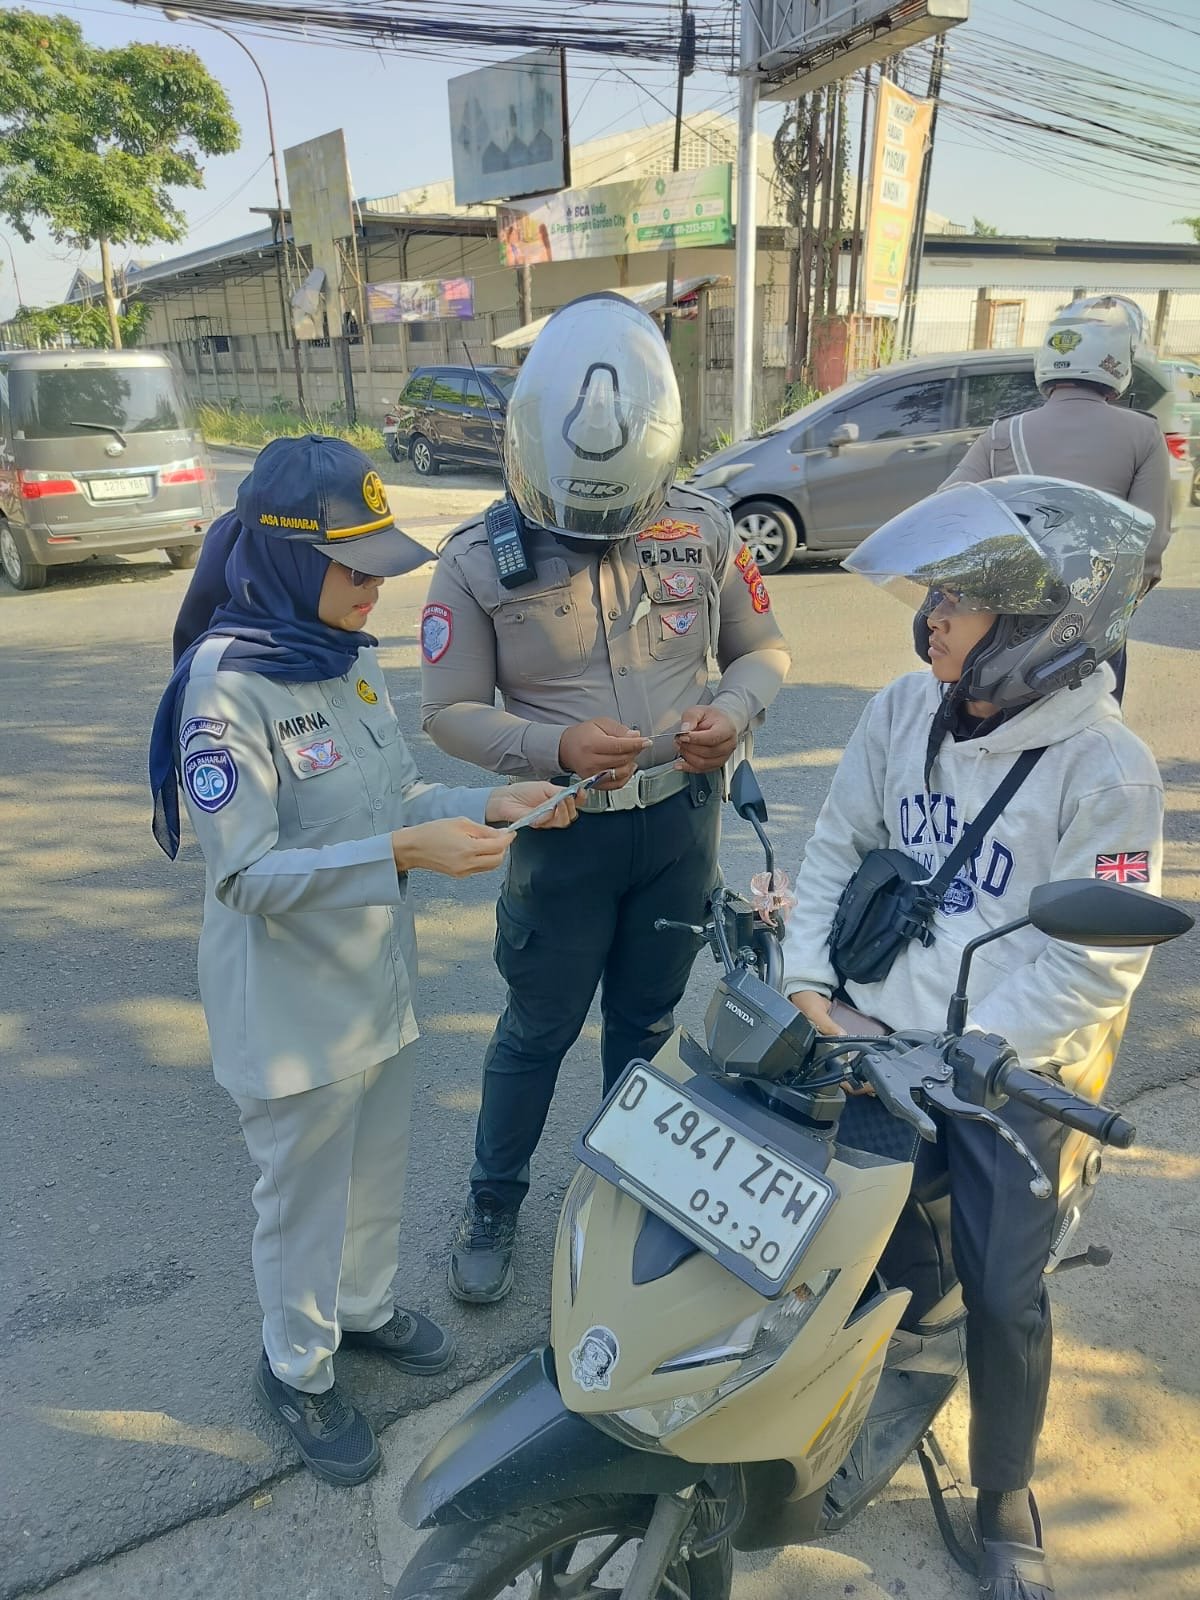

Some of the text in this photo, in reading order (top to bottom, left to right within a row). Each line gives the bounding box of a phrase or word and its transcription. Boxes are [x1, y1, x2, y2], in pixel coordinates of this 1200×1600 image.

[574, 204, 590, 217] BCA
[592, 216, 613, 229] Garden
[613, 214, 626, 228] City
[559, 479, 618, 497] INK
[259, 513, 319, 531] JASA RAHARJA
[278, 711, 330, 741] MIRNA
[196, 756, 227, 766] RAHARJA
[725, 1000, 755, 1027] HONDA
[618, 1074, 818, 1225] D 4941 ZFW
